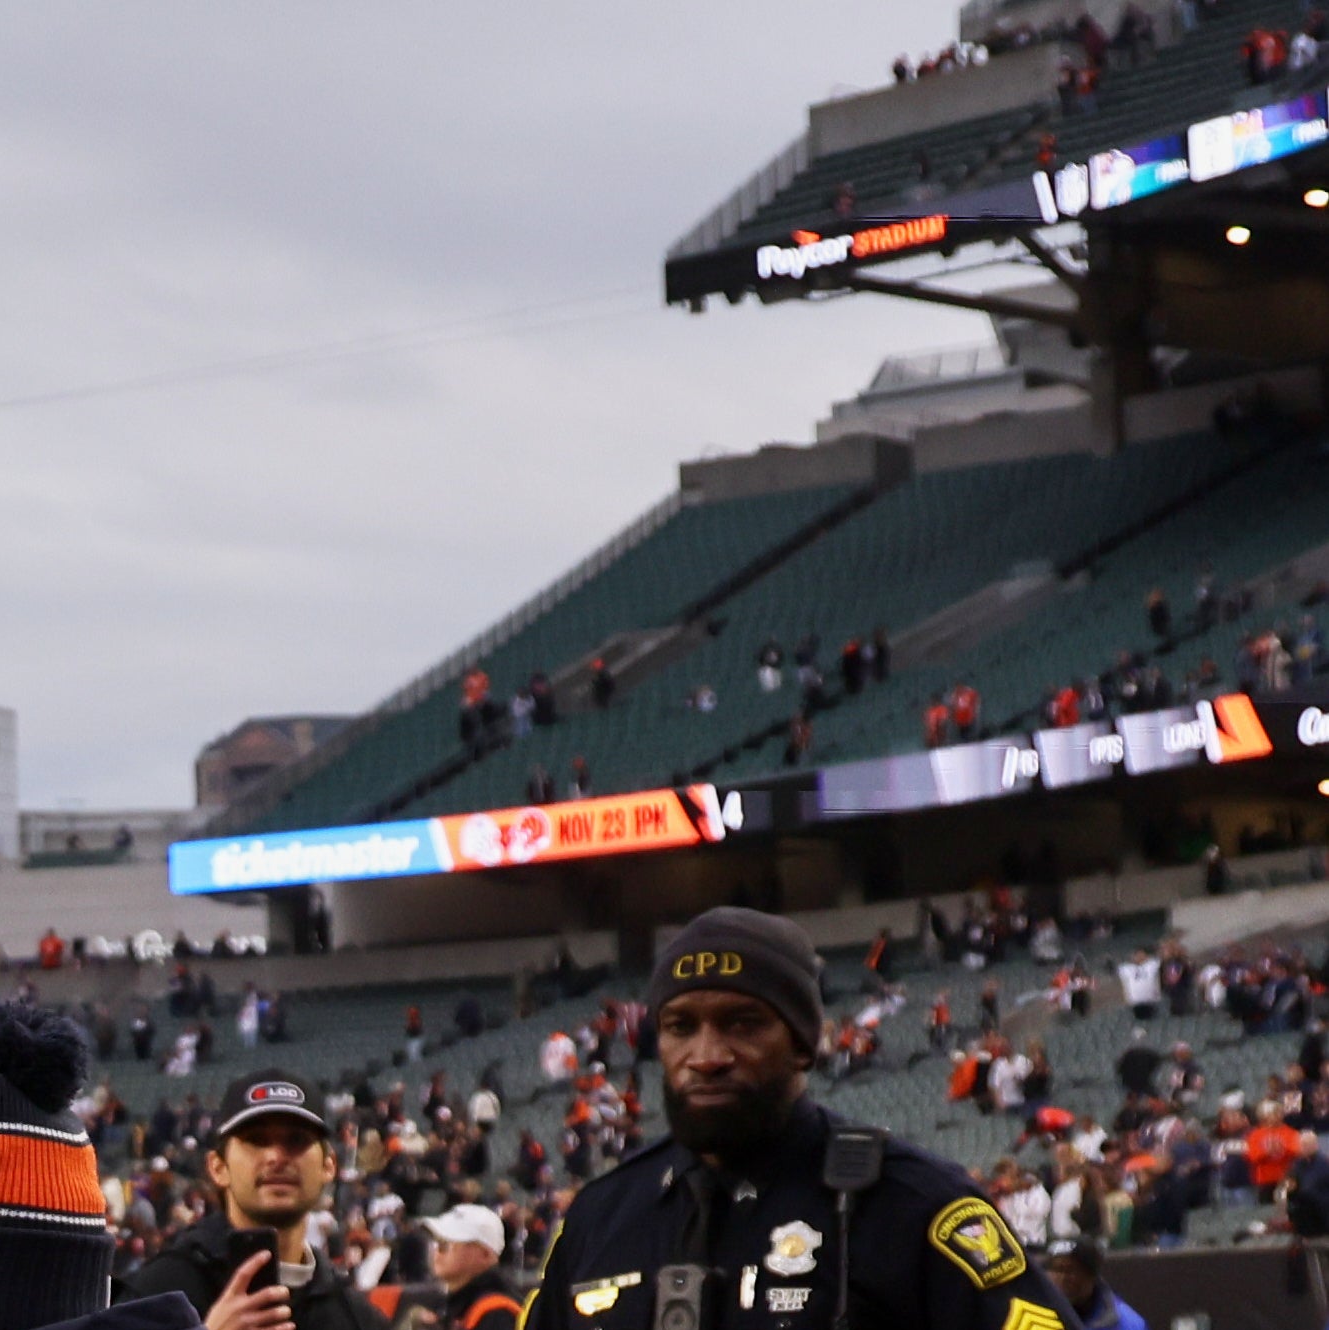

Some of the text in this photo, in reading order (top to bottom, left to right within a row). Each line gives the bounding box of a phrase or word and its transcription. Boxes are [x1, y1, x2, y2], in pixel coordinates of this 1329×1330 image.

[852, 215, 949, 258] STADIUM
[559, 802, 669, 846] NOV 23 1PM
[211, 835, 420, 887] ticketmaster
[672, 951, 743, 979] CPD
